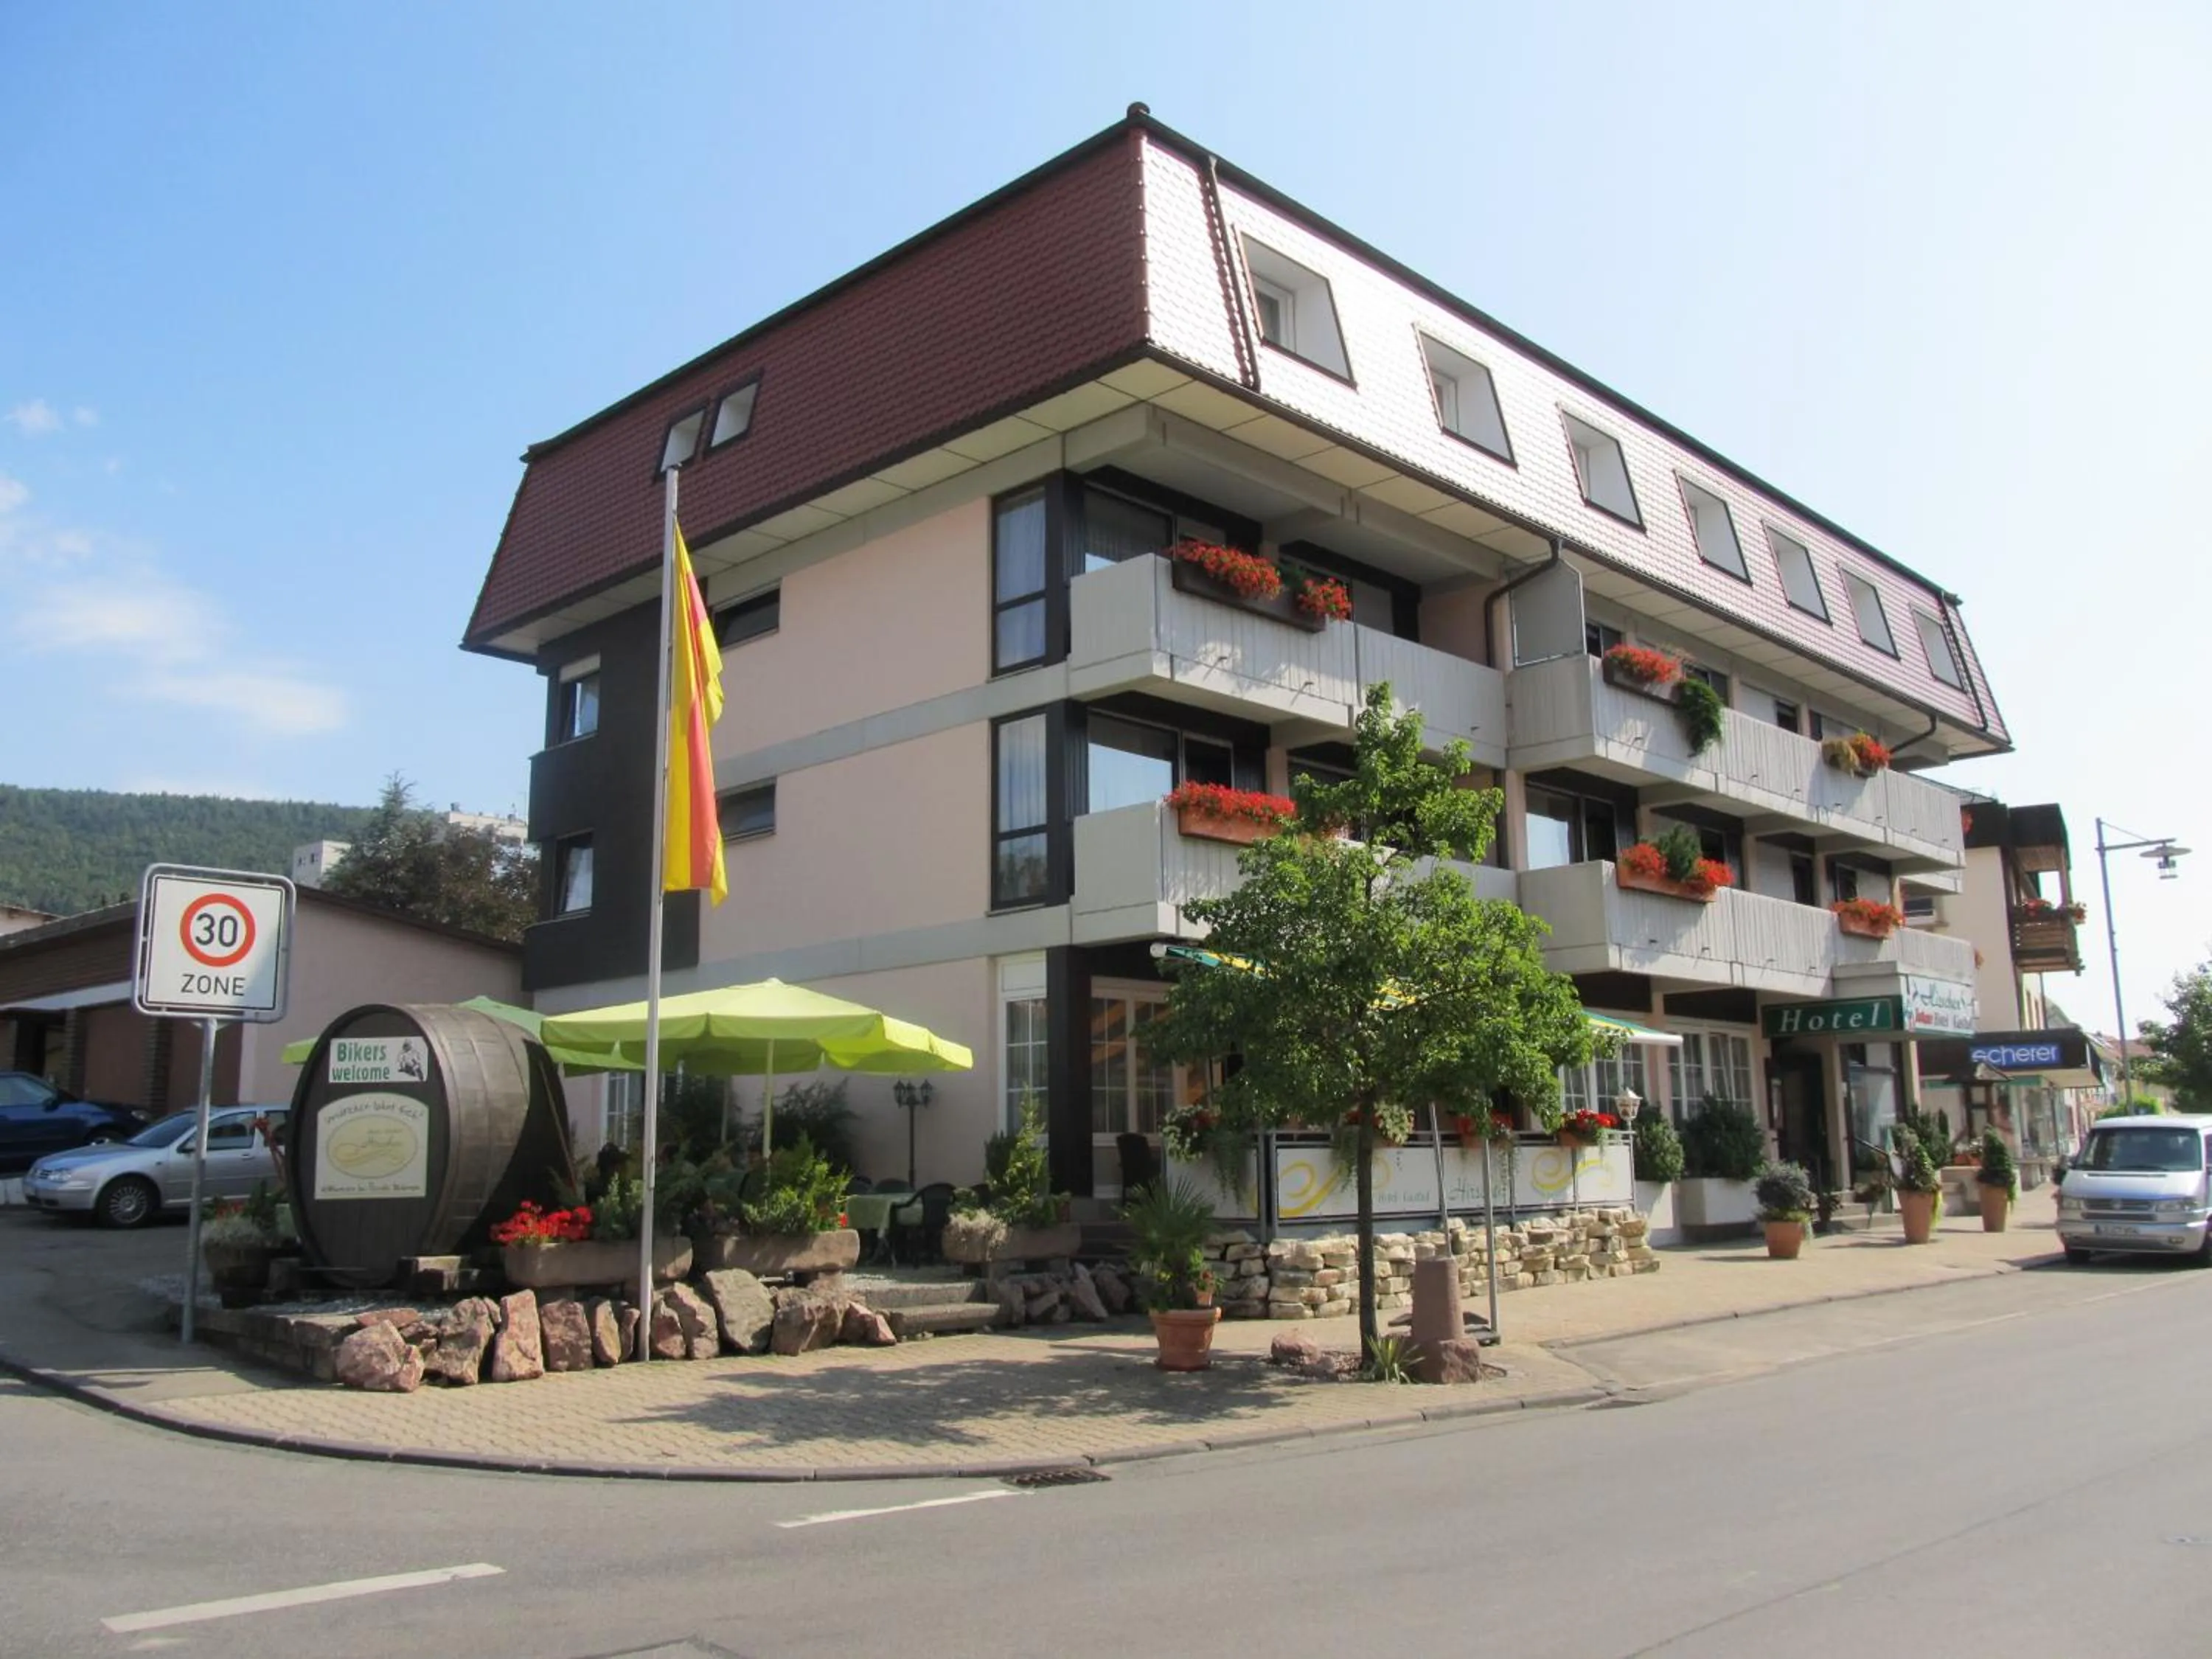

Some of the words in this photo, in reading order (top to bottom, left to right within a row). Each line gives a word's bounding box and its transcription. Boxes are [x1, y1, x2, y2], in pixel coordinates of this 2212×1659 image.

[195, 913, 238, 947] 30
[181, 974, 246, 996] ZONE
[1778, 1002, 1881, 1032] Hotel
[337, 1041, 387, 1062] Bikers
[332, 1065, 390, 1081] welcome
